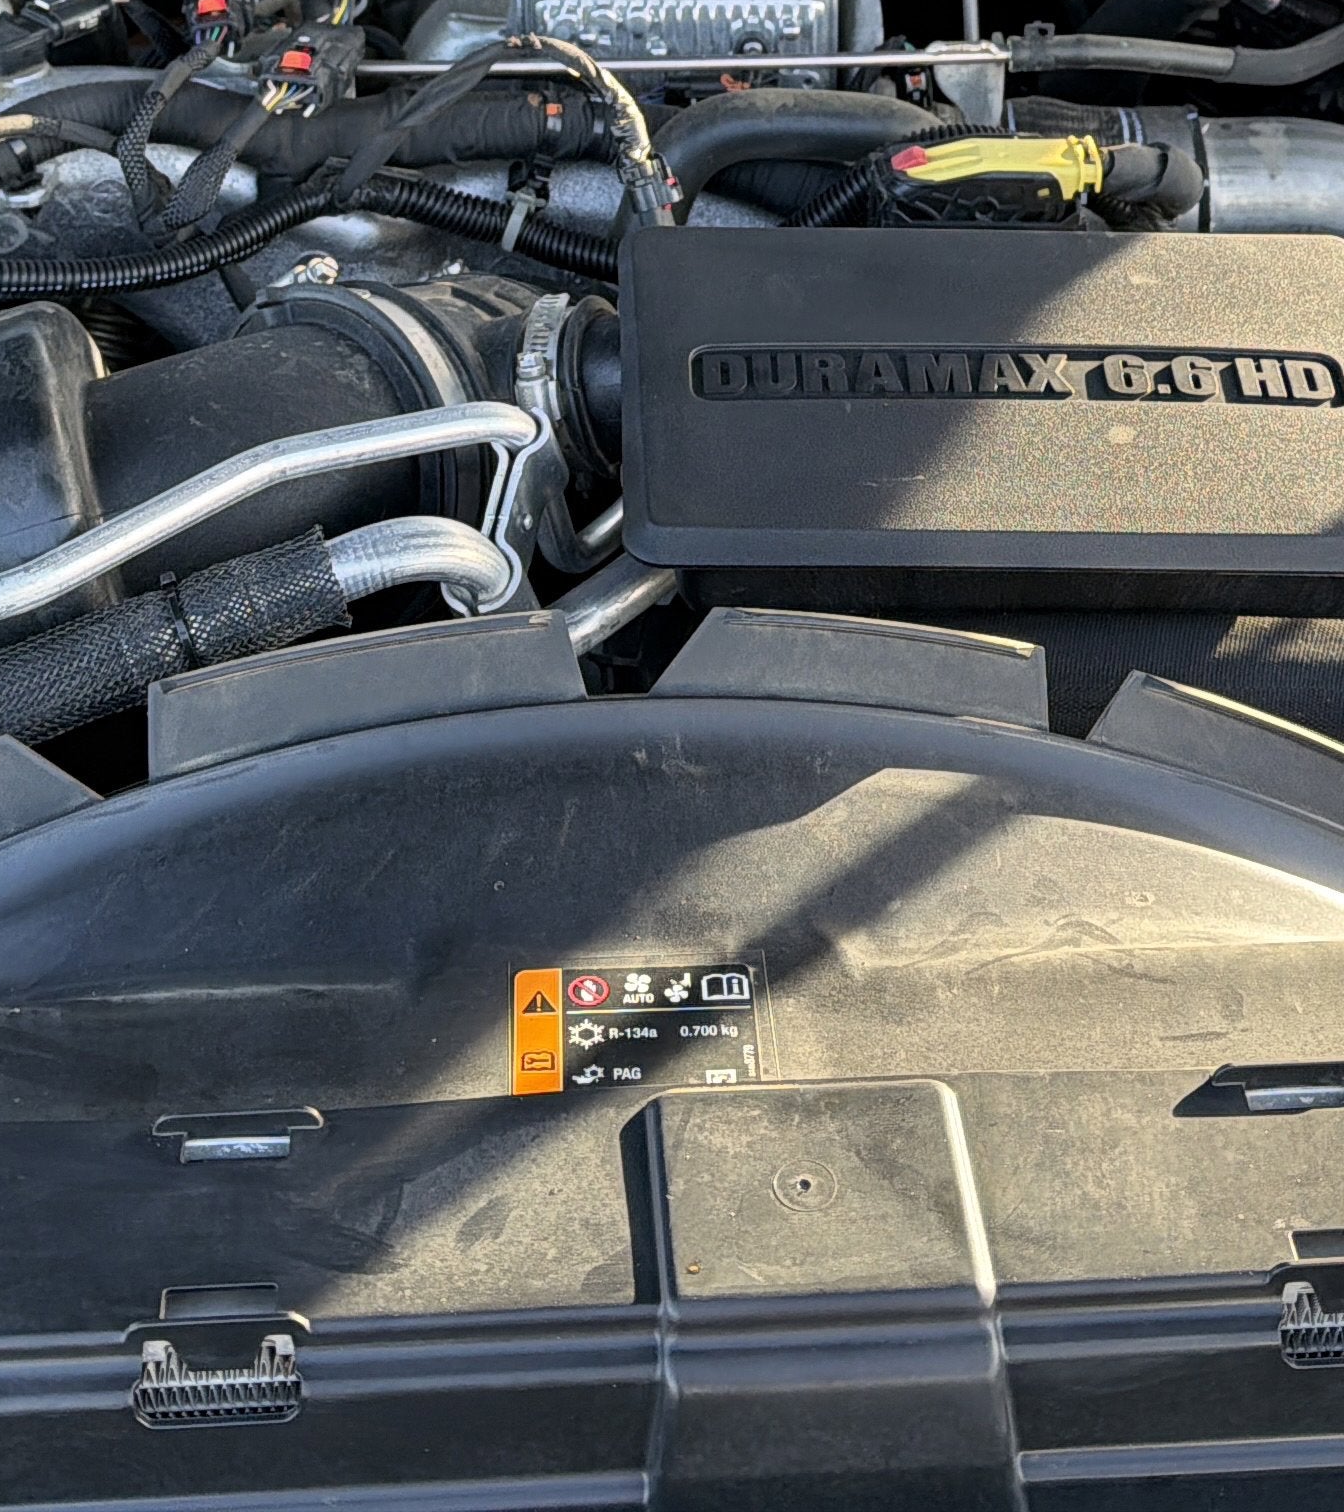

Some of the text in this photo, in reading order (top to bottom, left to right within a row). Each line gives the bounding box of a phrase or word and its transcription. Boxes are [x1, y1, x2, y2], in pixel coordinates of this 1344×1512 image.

[698, 351, 1338, 404] DURAMAX 6.6 HD
[622, 992, 655, 1005] AUTO
[608, 1023, 739, 1040] R-134a 0.700 kg
[612, 1066, 643, 1081] PAG
